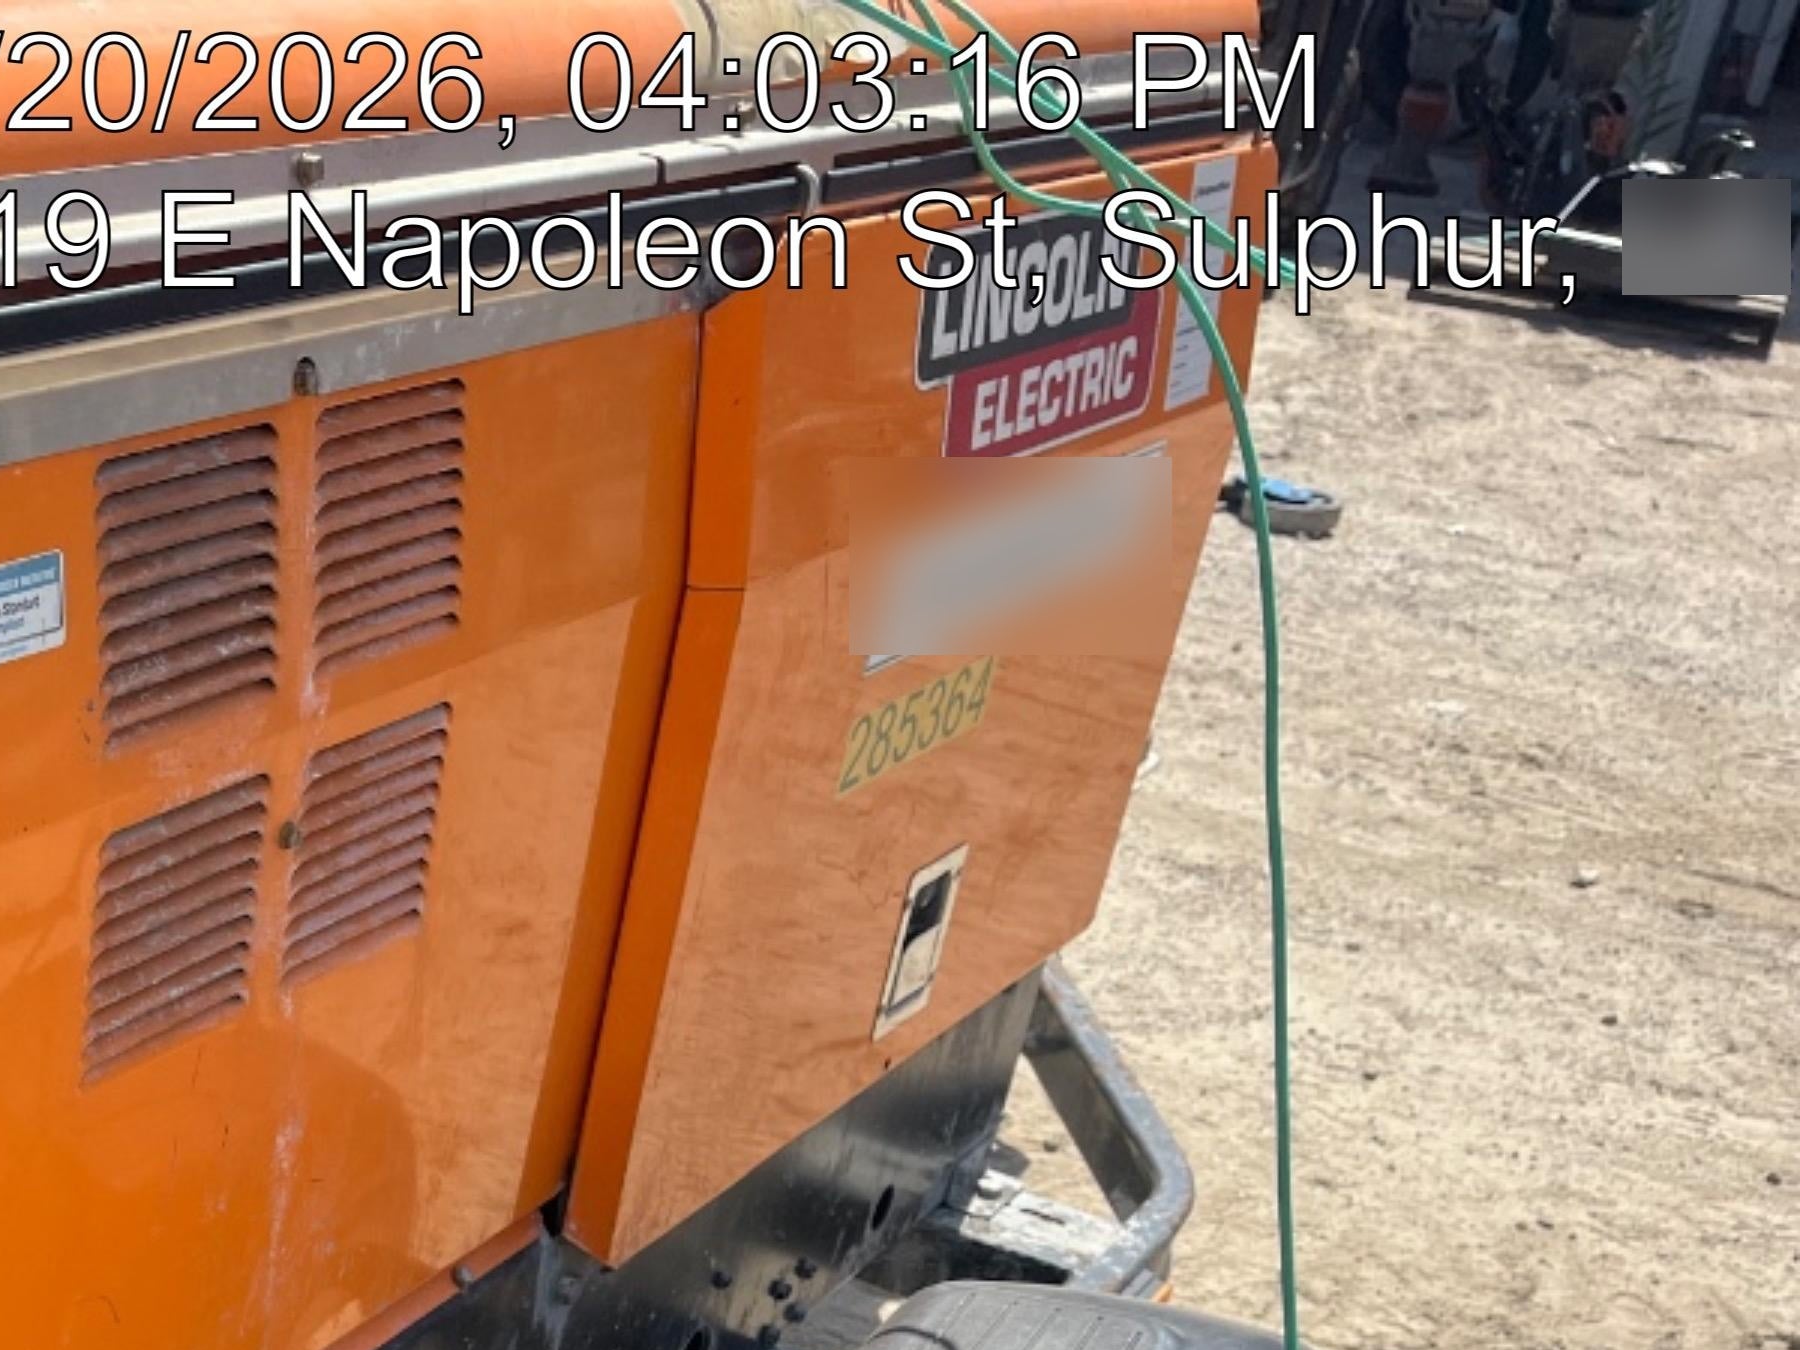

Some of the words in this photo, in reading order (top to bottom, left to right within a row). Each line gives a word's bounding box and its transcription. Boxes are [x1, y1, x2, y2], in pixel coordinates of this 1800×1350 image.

[930, 218, 1137, 361] LINCOLN
[971, 335, 1138, 452] ELECTRIC
[839, 655, 996, 794] 285364
